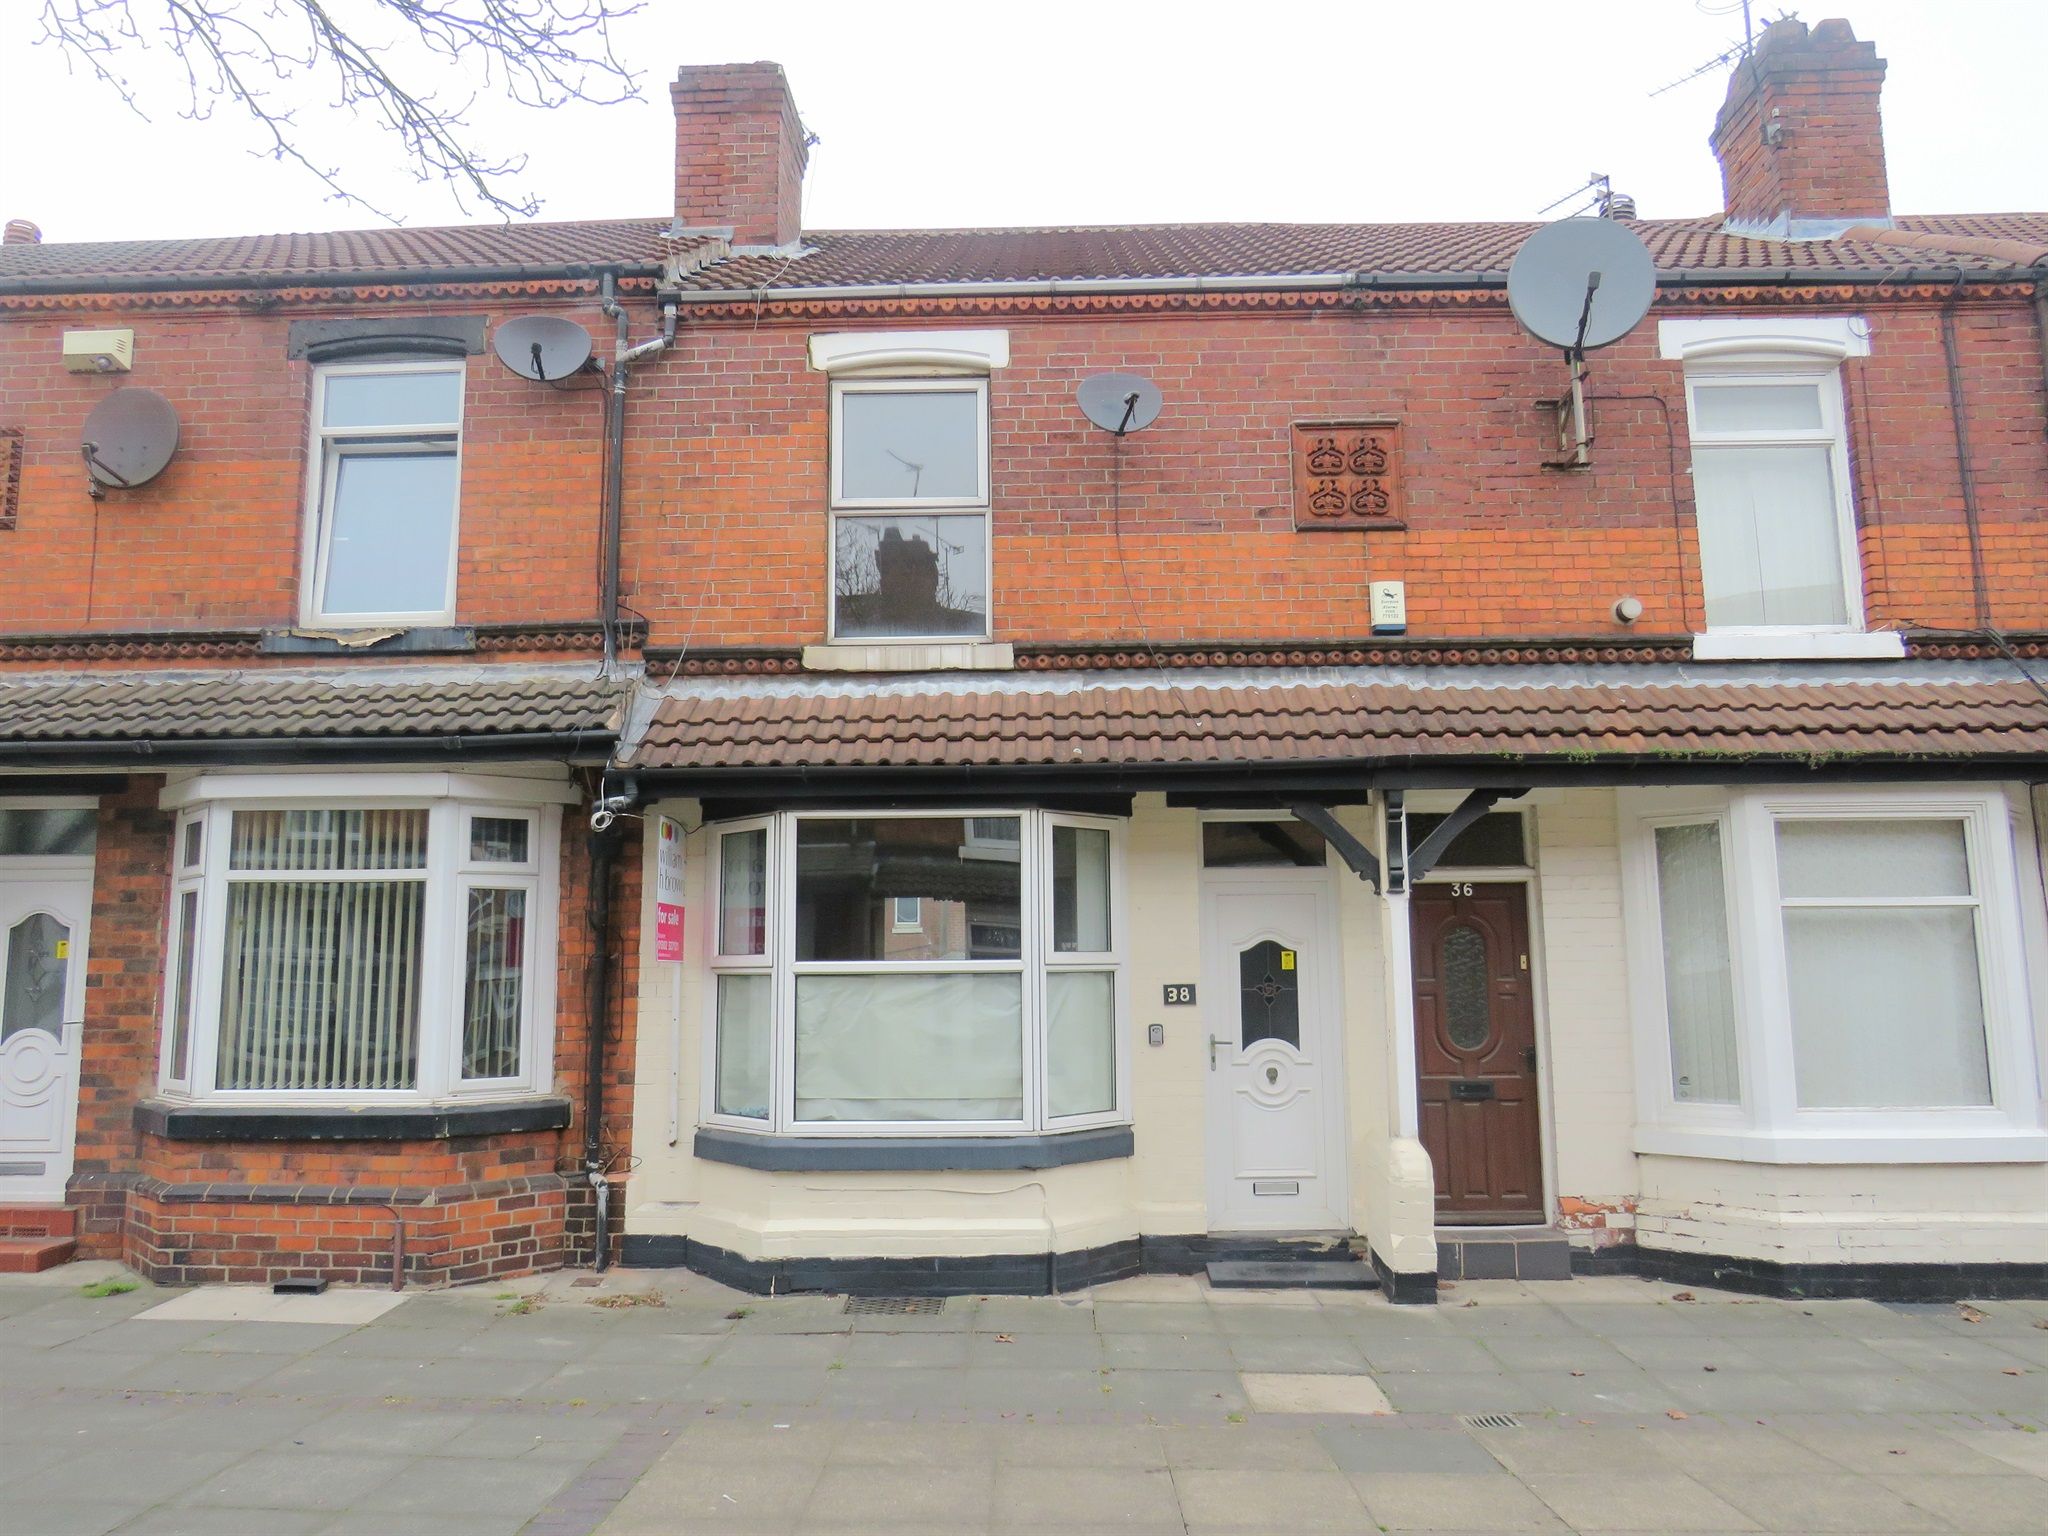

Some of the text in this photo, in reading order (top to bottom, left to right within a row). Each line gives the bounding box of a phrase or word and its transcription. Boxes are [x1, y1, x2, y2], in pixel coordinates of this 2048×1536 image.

[1451, 883, 1473, 897] 36
[658, 906, 680, 926] for sale
[1167, 986, 1190, 1003] 38
